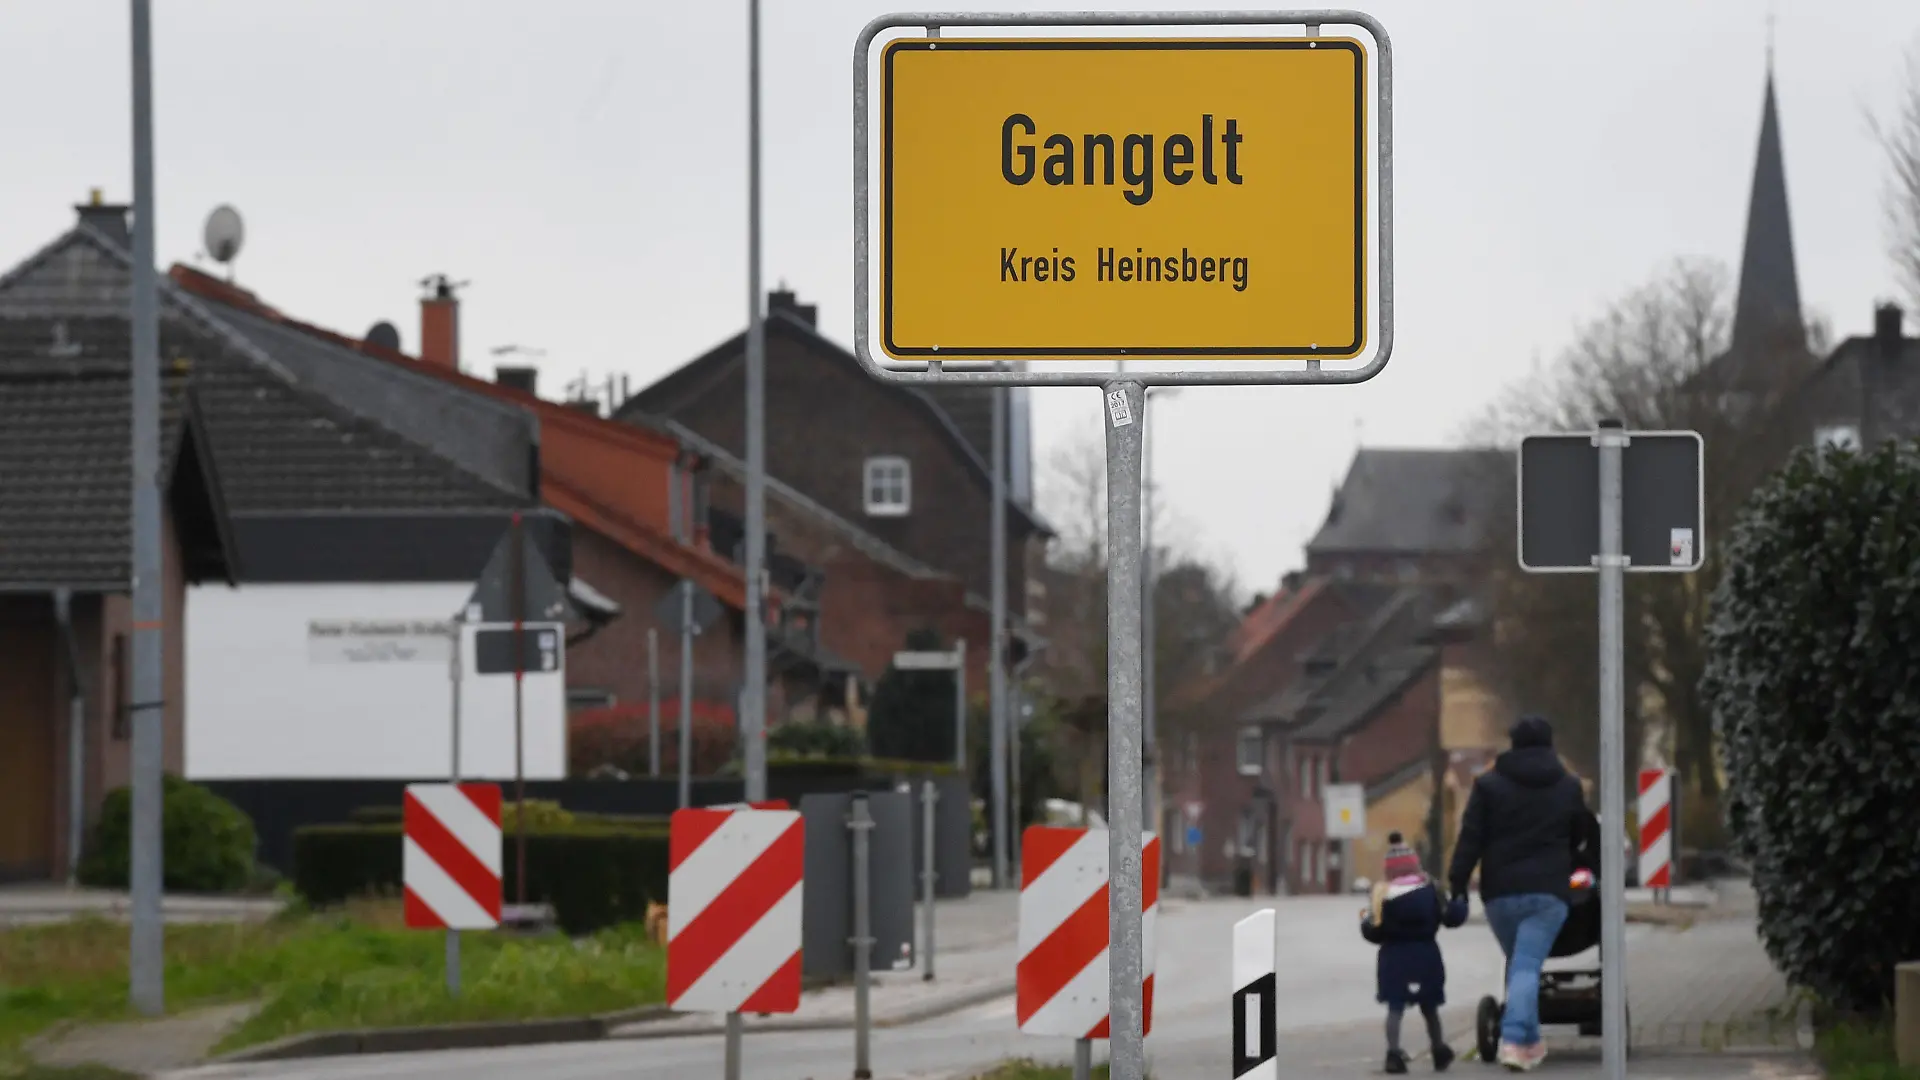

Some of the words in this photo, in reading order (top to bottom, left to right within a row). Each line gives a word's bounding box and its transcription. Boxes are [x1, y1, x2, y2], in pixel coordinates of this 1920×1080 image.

[1001, 113, 1243, 206] Gangelt
[1000, 247, 1076, 282] Kreis
[1097, 247, 1248, 292] Heinsberg
